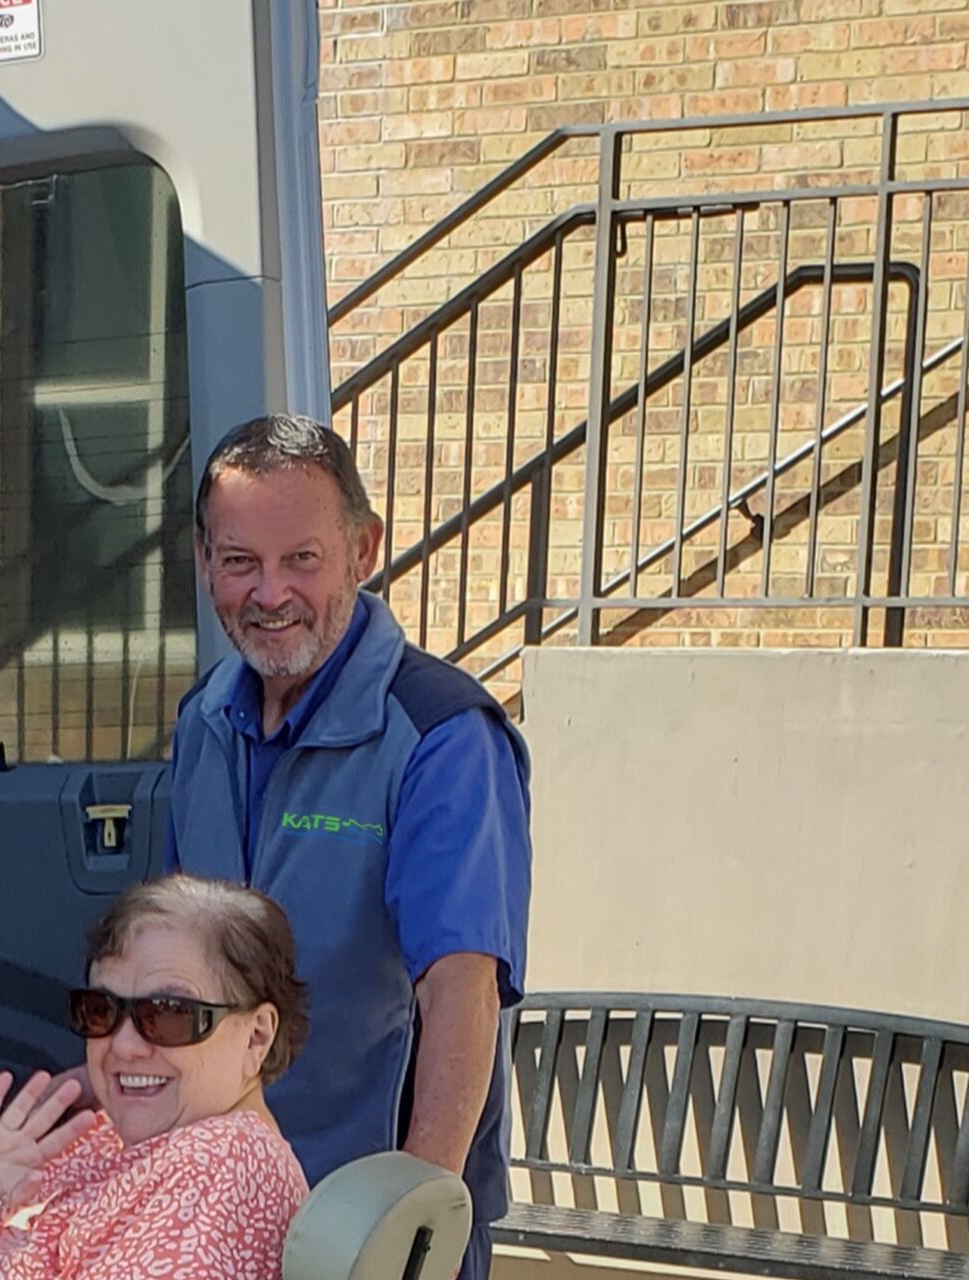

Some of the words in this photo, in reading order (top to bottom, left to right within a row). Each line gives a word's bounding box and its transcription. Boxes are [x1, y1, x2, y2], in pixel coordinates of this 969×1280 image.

[20, 32, 35, 41] AND
[14, 43, 22, 51] IN
[23, 42, 37, 50] USE
